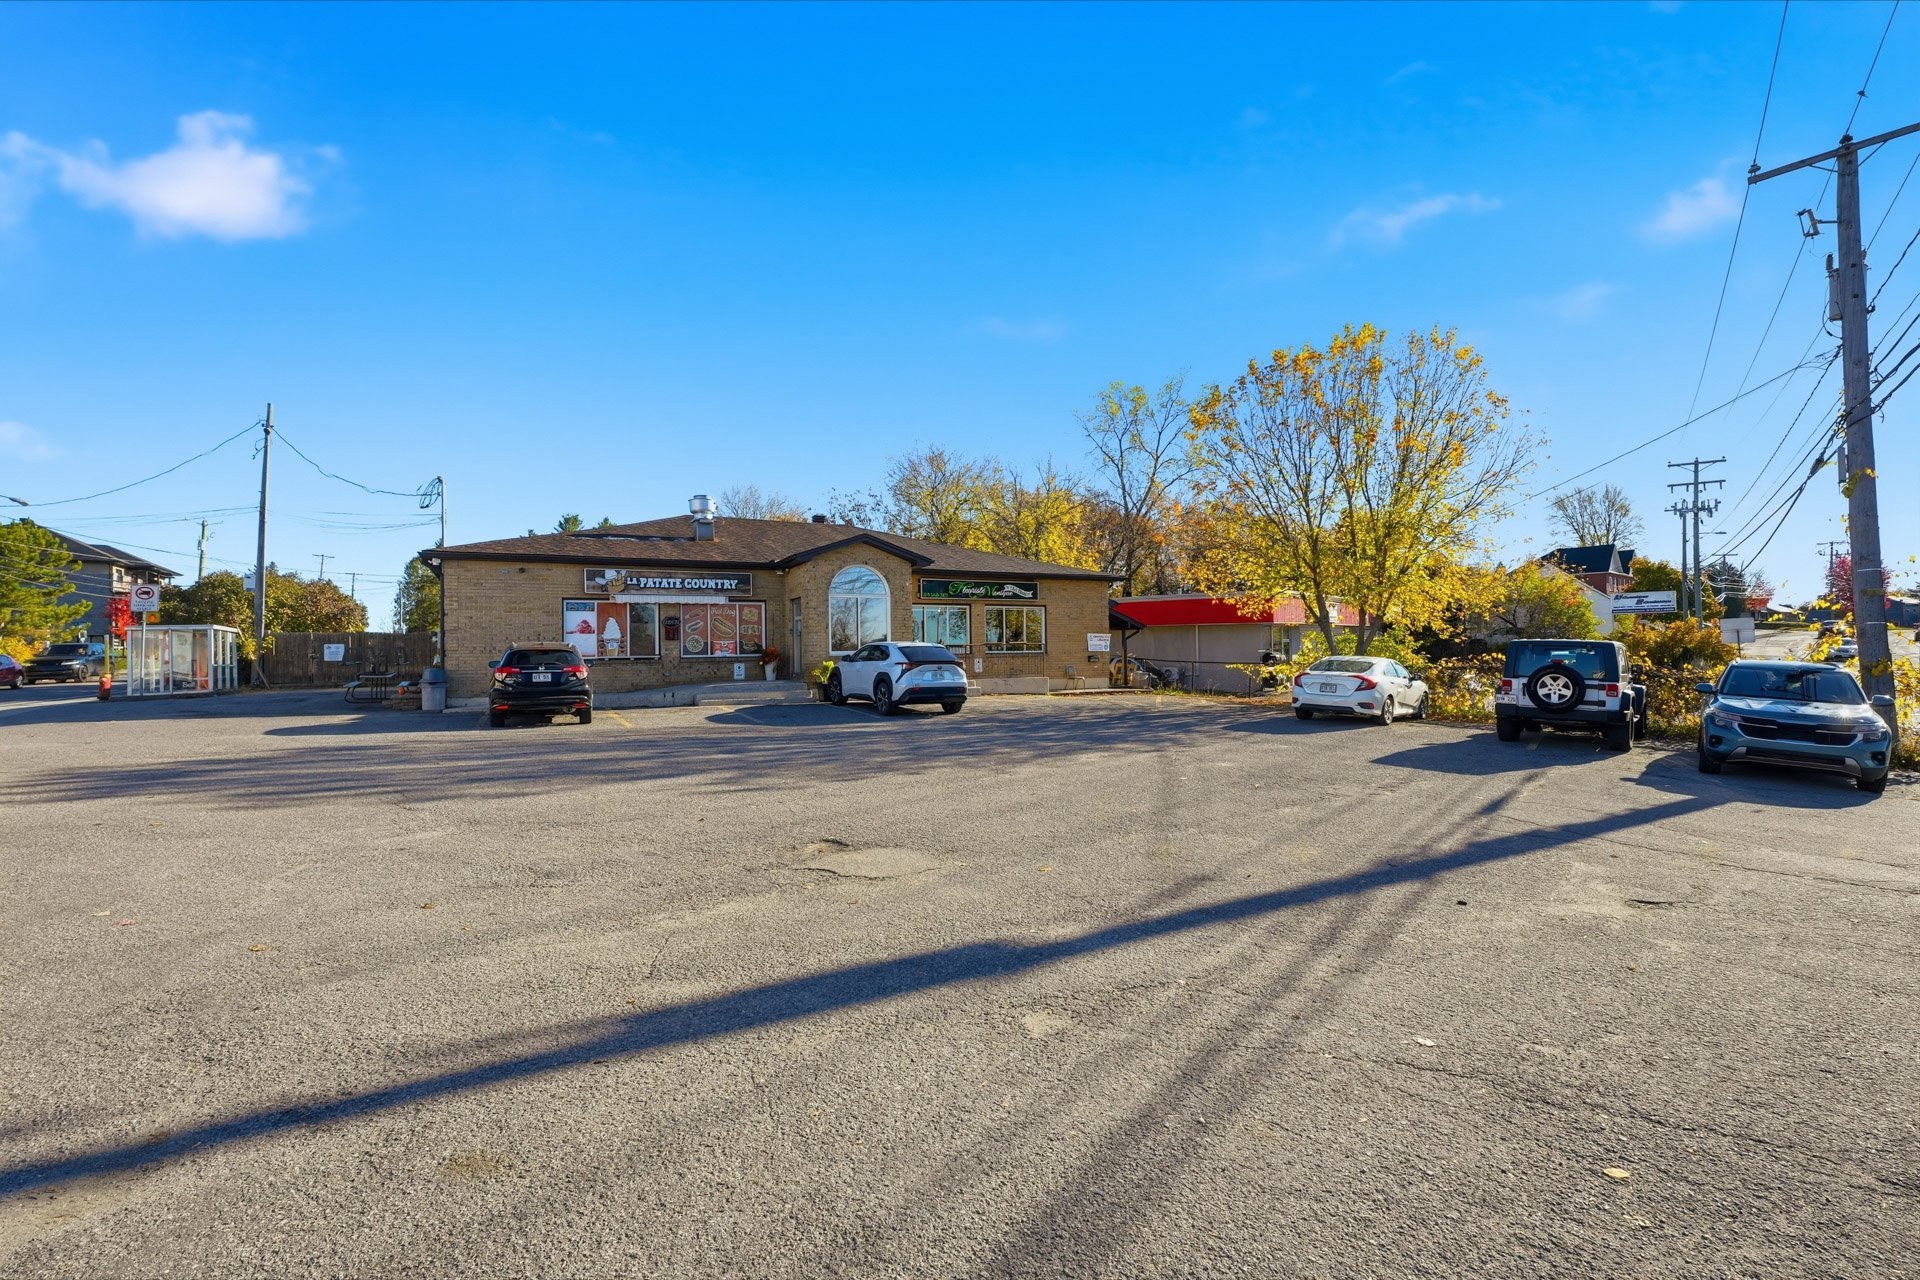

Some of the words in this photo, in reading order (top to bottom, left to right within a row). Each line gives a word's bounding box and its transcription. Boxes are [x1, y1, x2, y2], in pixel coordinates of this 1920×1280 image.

[626, 577, 638, 585] LA
[639, 577, 683, 588] PATATE
[684, 578, 738, 590] COUNTRY
[723, 607, 736, 616] Dog
